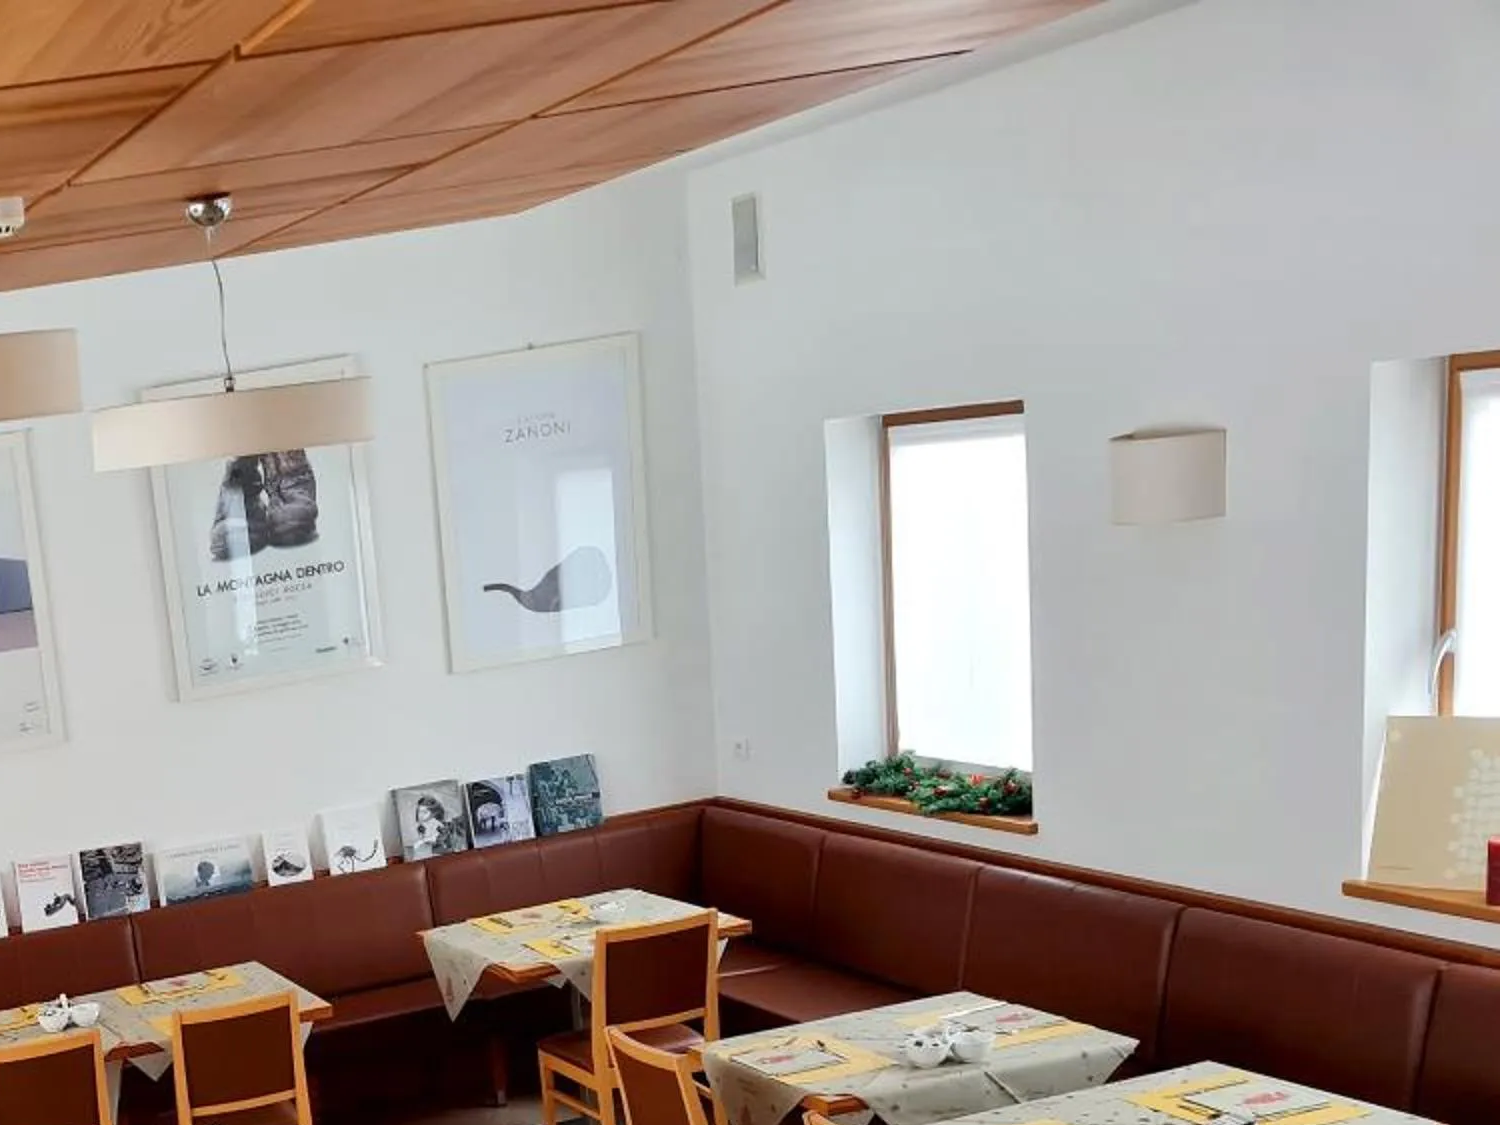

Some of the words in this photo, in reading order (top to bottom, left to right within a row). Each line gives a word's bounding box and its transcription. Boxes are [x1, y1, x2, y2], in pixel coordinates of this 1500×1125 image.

[503, 420, 571, 443] ZANONI
[196, 584, 213, 598] LA
[295, 560, 345, 580] DENTRO
